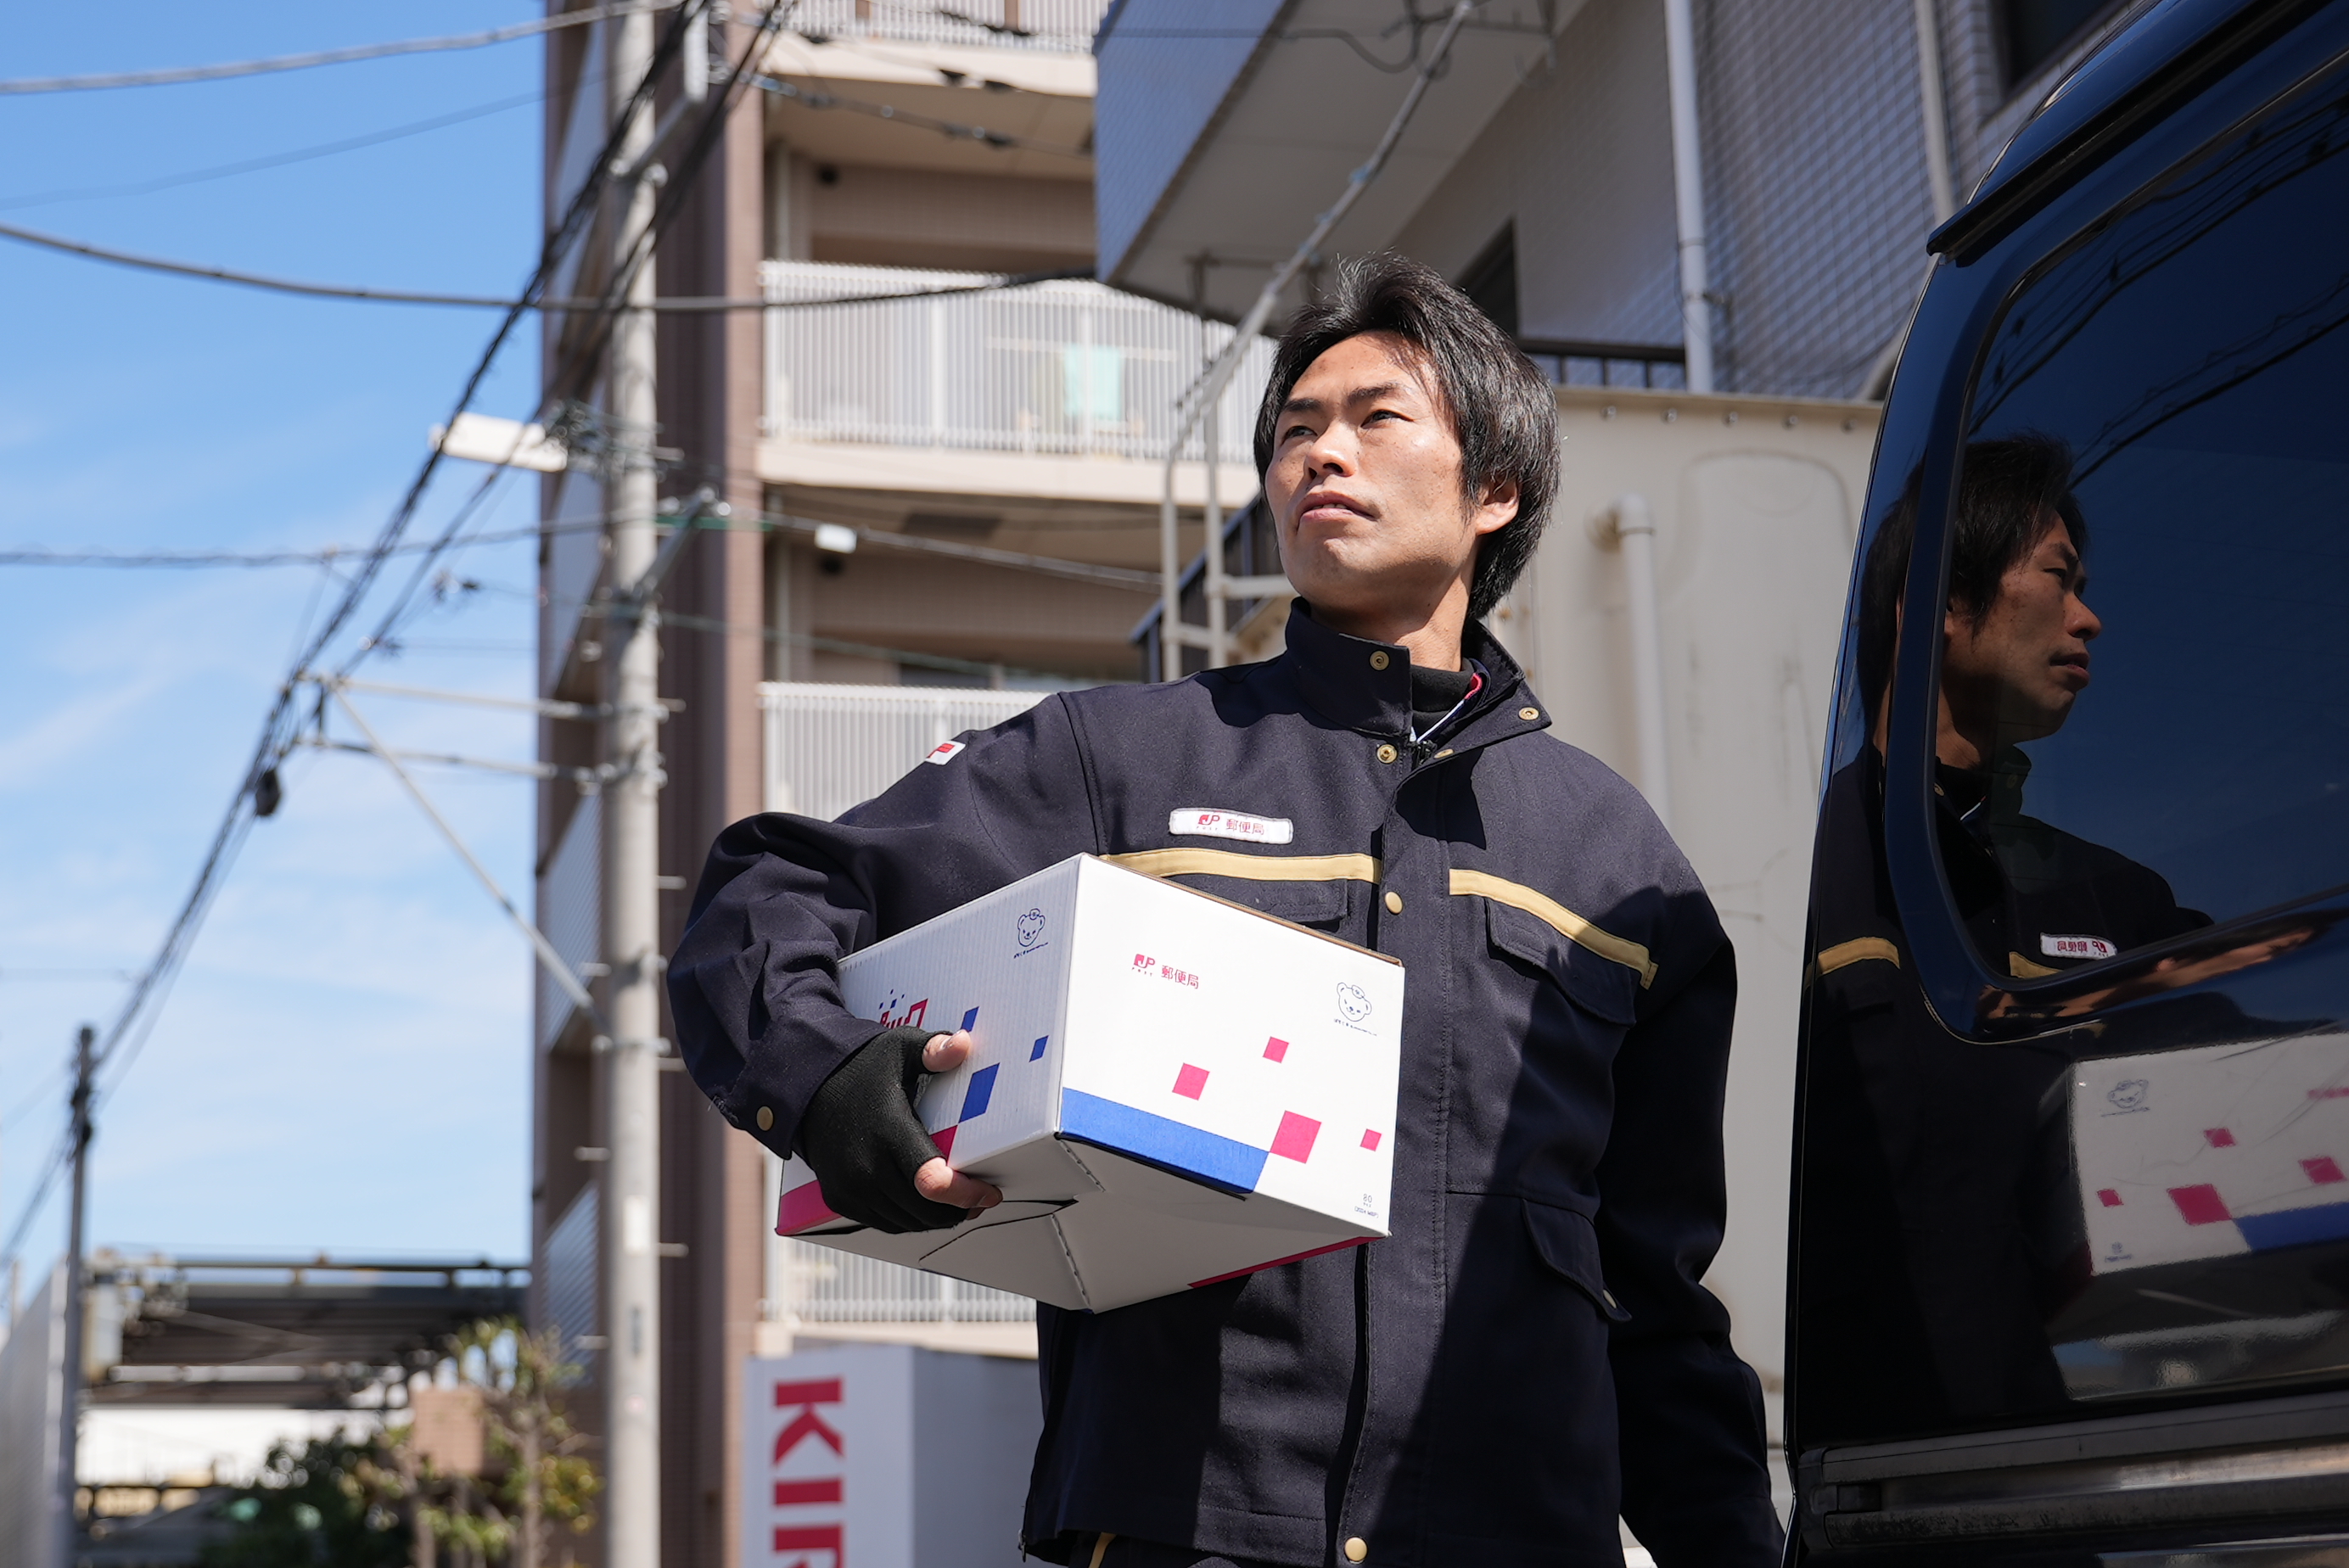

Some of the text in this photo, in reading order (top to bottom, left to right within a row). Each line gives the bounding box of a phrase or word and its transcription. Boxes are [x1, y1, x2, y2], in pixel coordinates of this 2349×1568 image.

[1225, 818, 1264, 836] 郵便局
[1161, 965, 1198, 989] 郵便局
